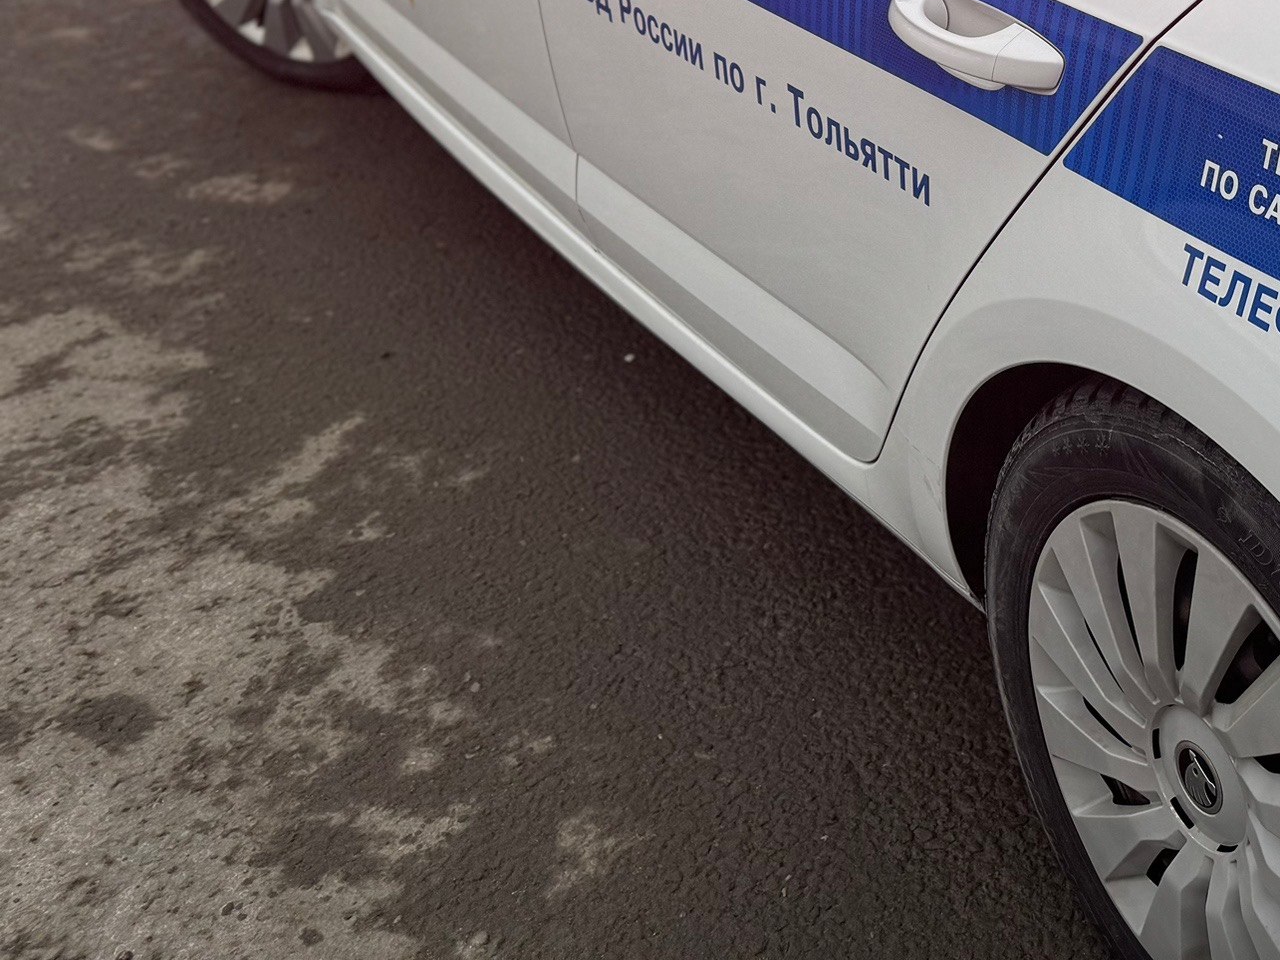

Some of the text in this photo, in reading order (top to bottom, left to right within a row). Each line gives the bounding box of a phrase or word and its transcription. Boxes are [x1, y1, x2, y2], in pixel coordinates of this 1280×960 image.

[713, 51, 745, 93] по
[755, 75, 776, 113] г.
[786, 83, 930, 207] Тольятти
[1200, 159, 1240, 202] ПО
